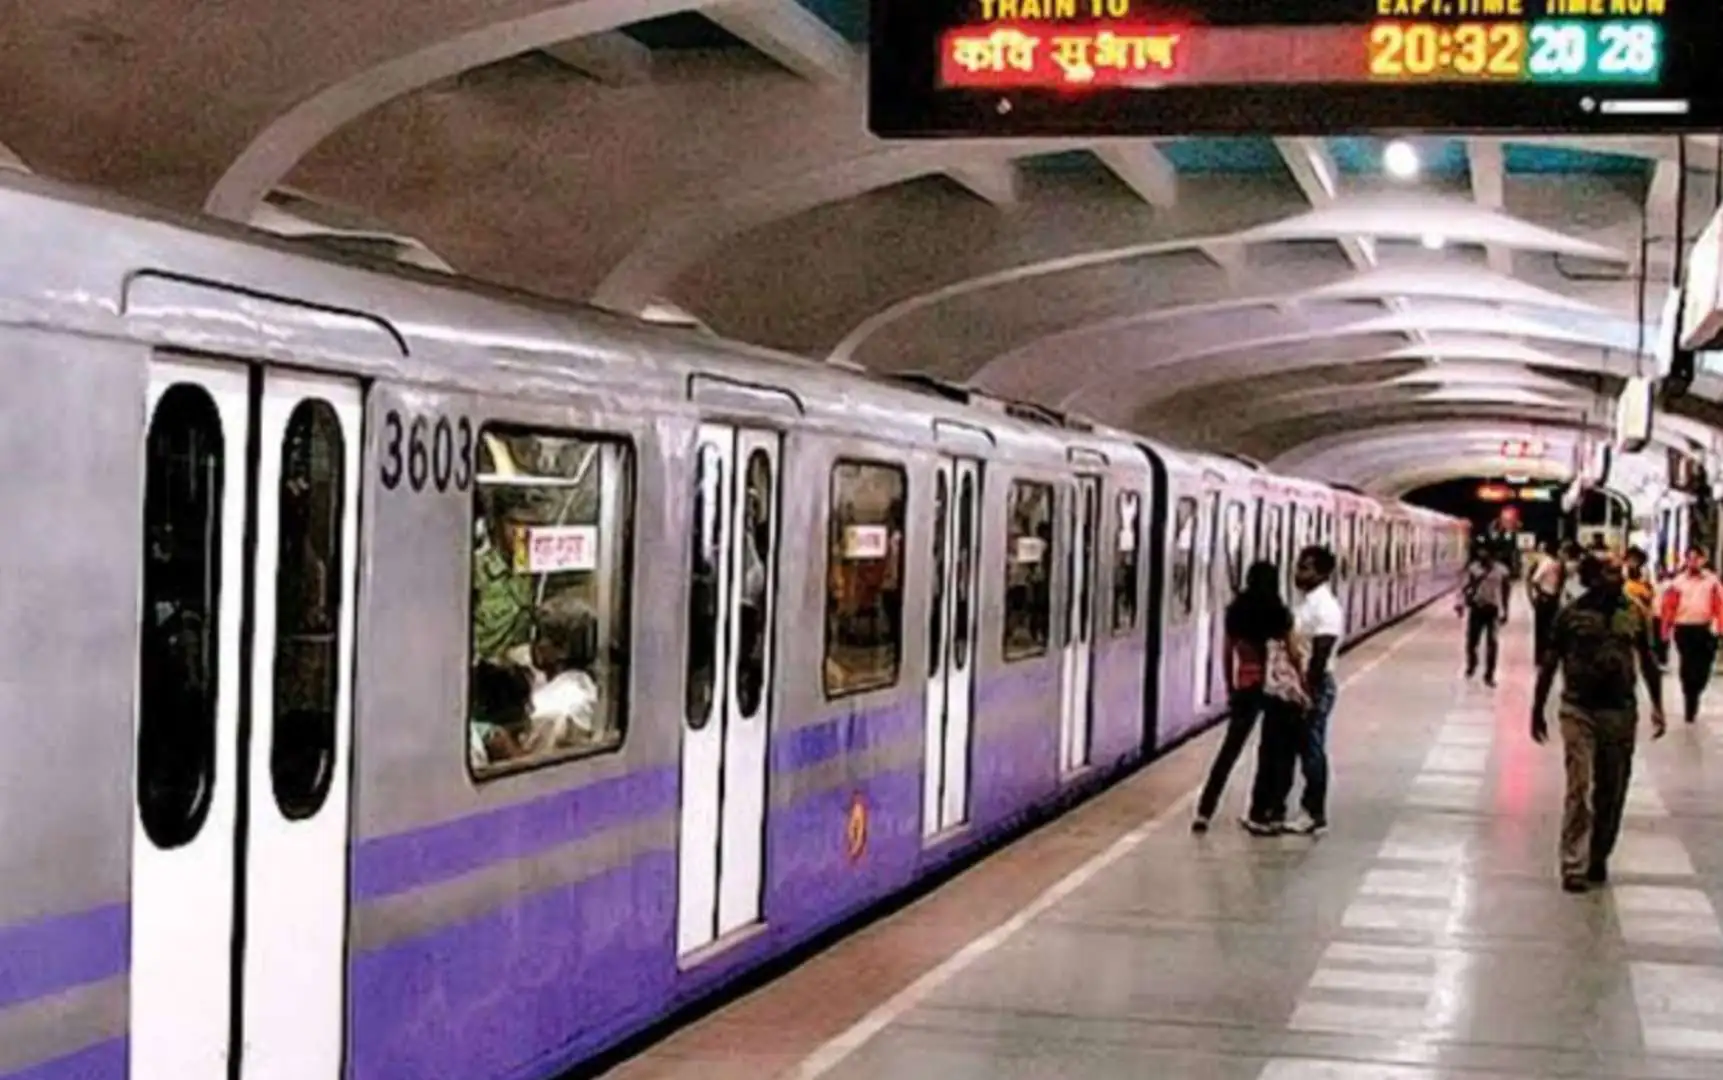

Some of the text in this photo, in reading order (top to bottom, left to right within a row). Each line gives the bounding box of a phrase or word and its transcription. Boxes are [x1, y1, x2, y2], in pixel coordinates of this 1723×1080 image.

[980, 0, 1130, 19] TRAIN TO
[953, 29, 1041, 71] कवि
[1370, 23, 1520, 75] 20:32
[1529, 23, 1657, 74] 20 28
[381, 408, 472, 493] 3603
